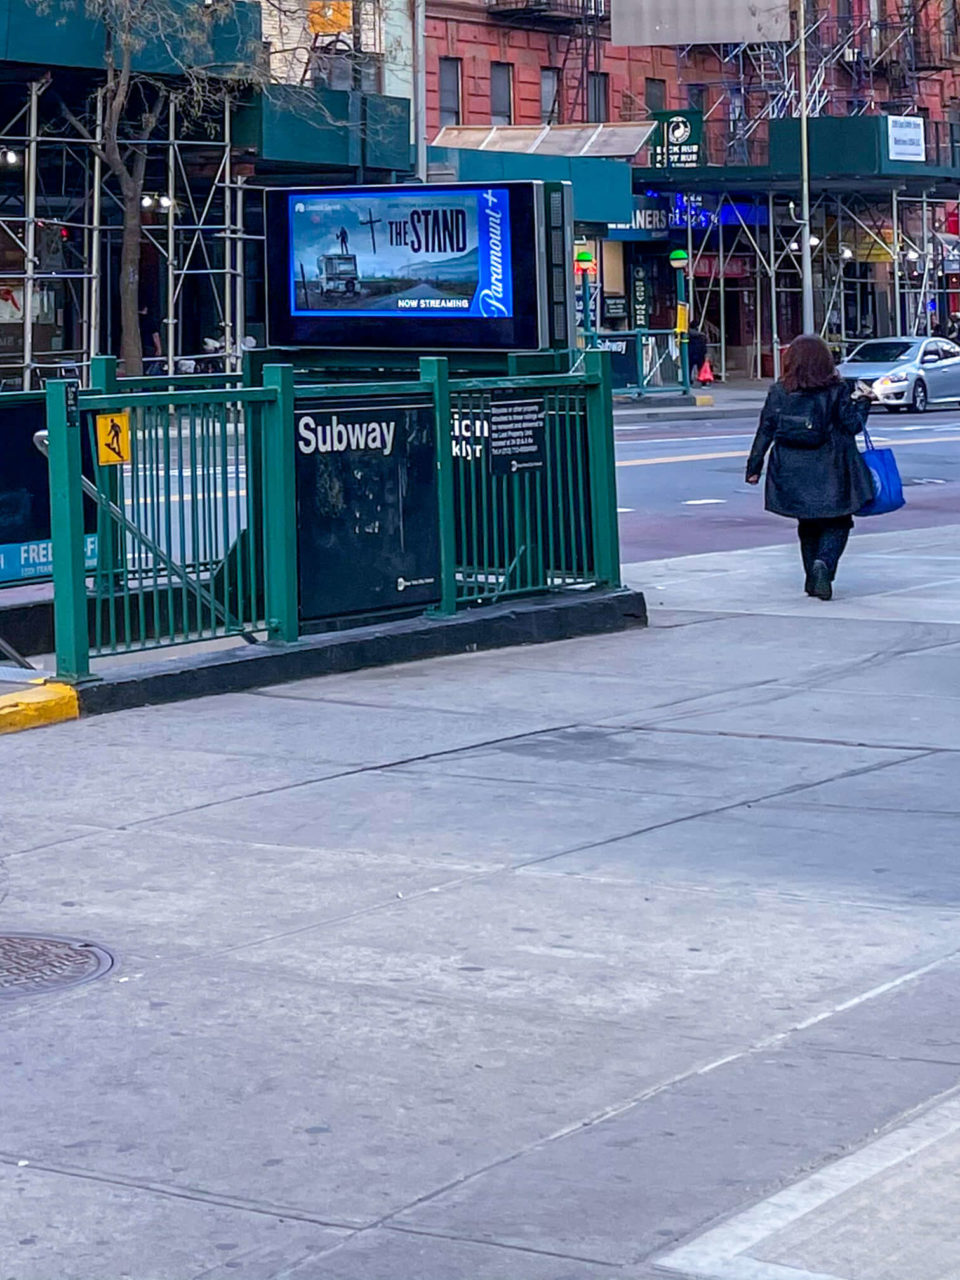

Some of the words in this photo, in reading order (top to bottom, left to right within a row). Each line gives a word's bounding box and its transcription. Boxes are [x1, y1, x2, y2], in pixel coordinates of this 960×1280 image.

[388, 220, 409, 247] THE
[410, 208, 468, 254] STAND
[397, 299, 418, 308] NOW
[420, 298, 469, 308] STREAMING
[297, 415, 396, 456] Subway
